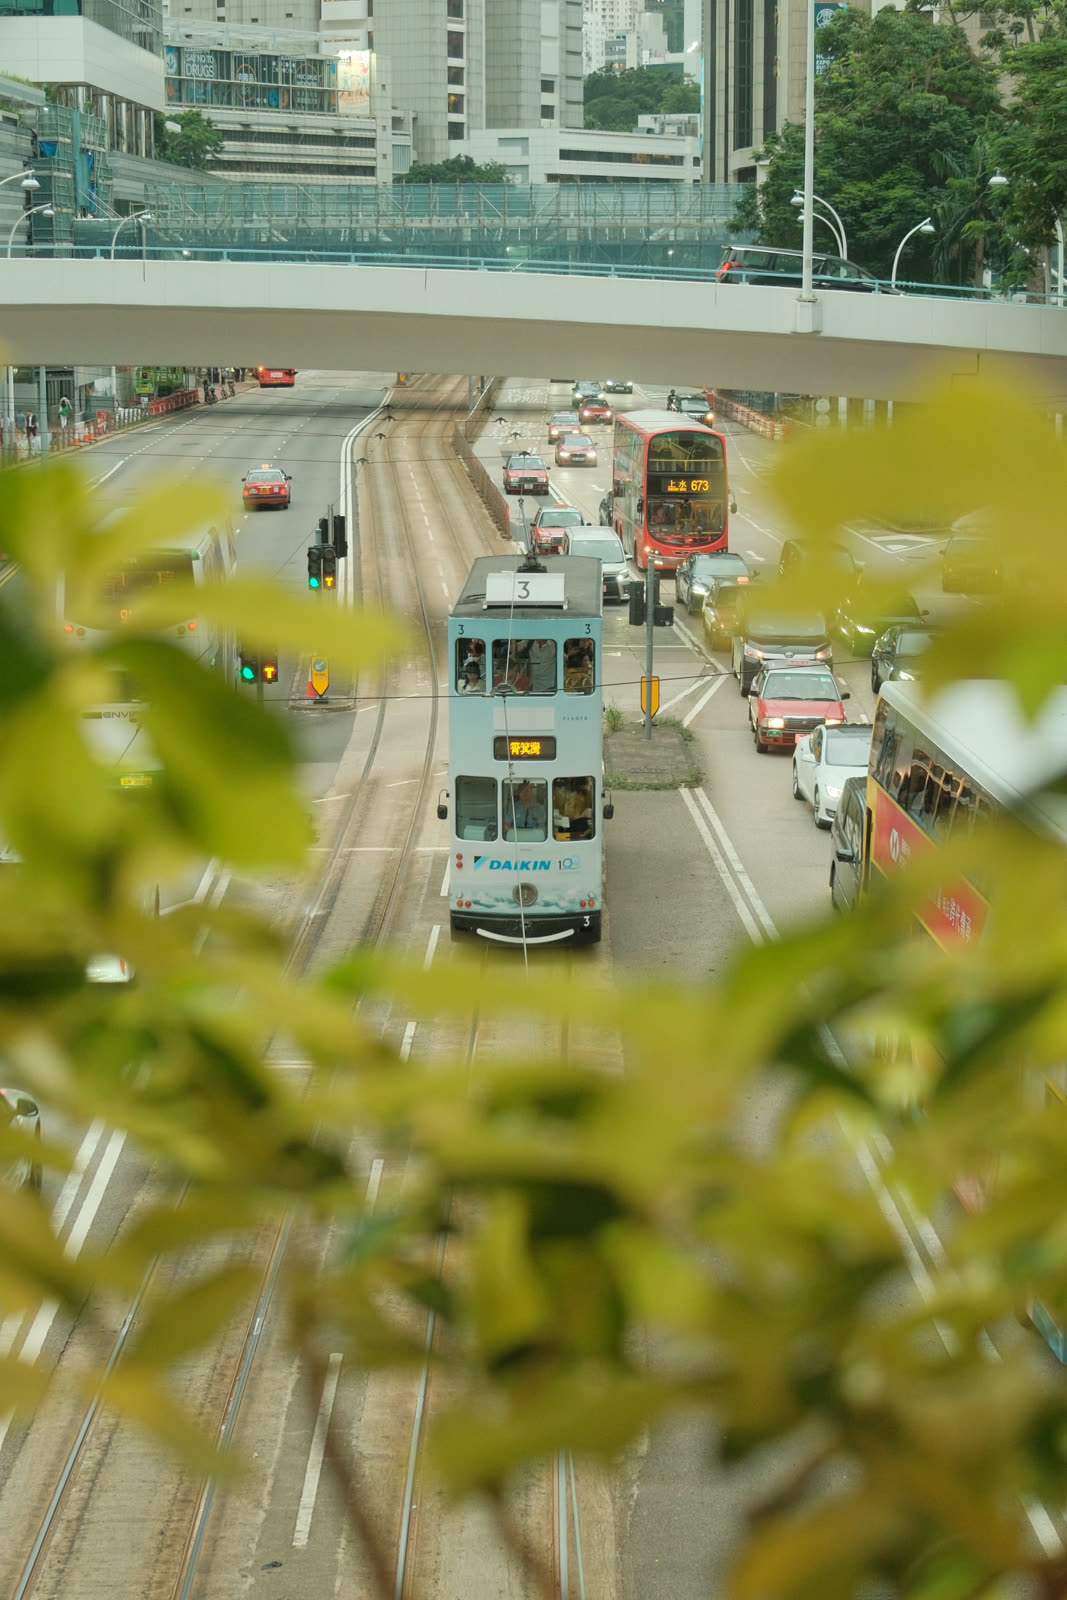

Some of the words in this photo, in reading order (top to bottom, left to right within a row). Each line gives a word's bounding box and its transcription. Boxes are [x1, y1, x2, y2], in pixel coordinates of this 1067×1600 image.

[185, 53, 195, 62] SAY
[196, 54, 206, 64] NO
[205, 55, 214, 64] TO
[185, 63, 215, 77] DRUGS
[667, 480, 687, 488] 上水
[691, 480, 709, 491] 673
[517, 581, 530, 599] 3
[458, 624, 465, 635] 3
[585, 624, 591, 634] 3
[489, 860, 551, 871] DAIKIN
[583, 916, 590, 927] 3
